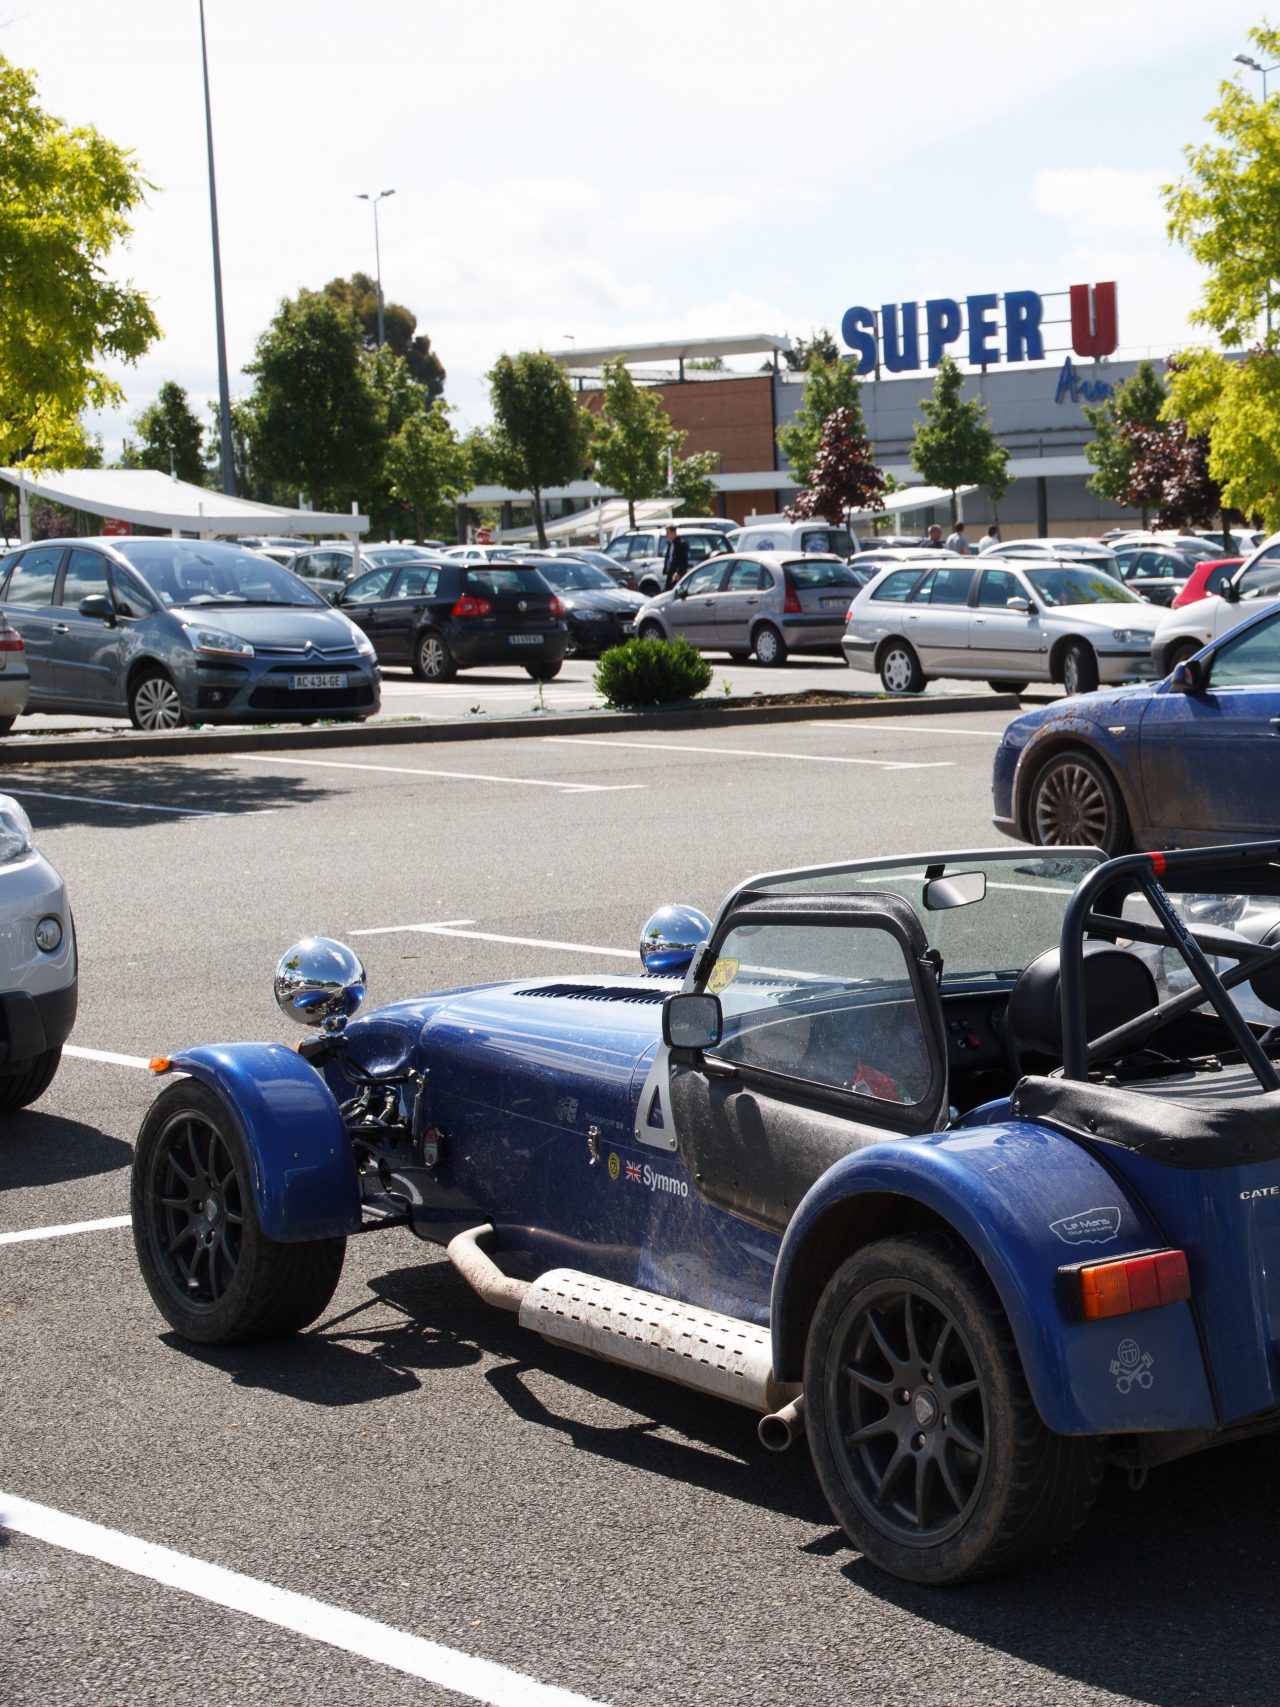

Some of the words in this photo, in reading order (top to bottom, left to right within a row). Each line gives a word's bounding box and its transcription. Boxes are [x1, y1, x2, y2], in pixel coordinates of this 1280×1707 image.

[841, 289, 1045, 376] SUPER
[1069, 280, 1117, 357] U
[643, 1164, 689, 1197] Symmo
[1063, 1223, 1078, 1231] Le
[1079, 1218, 1110, 1228] Mans
